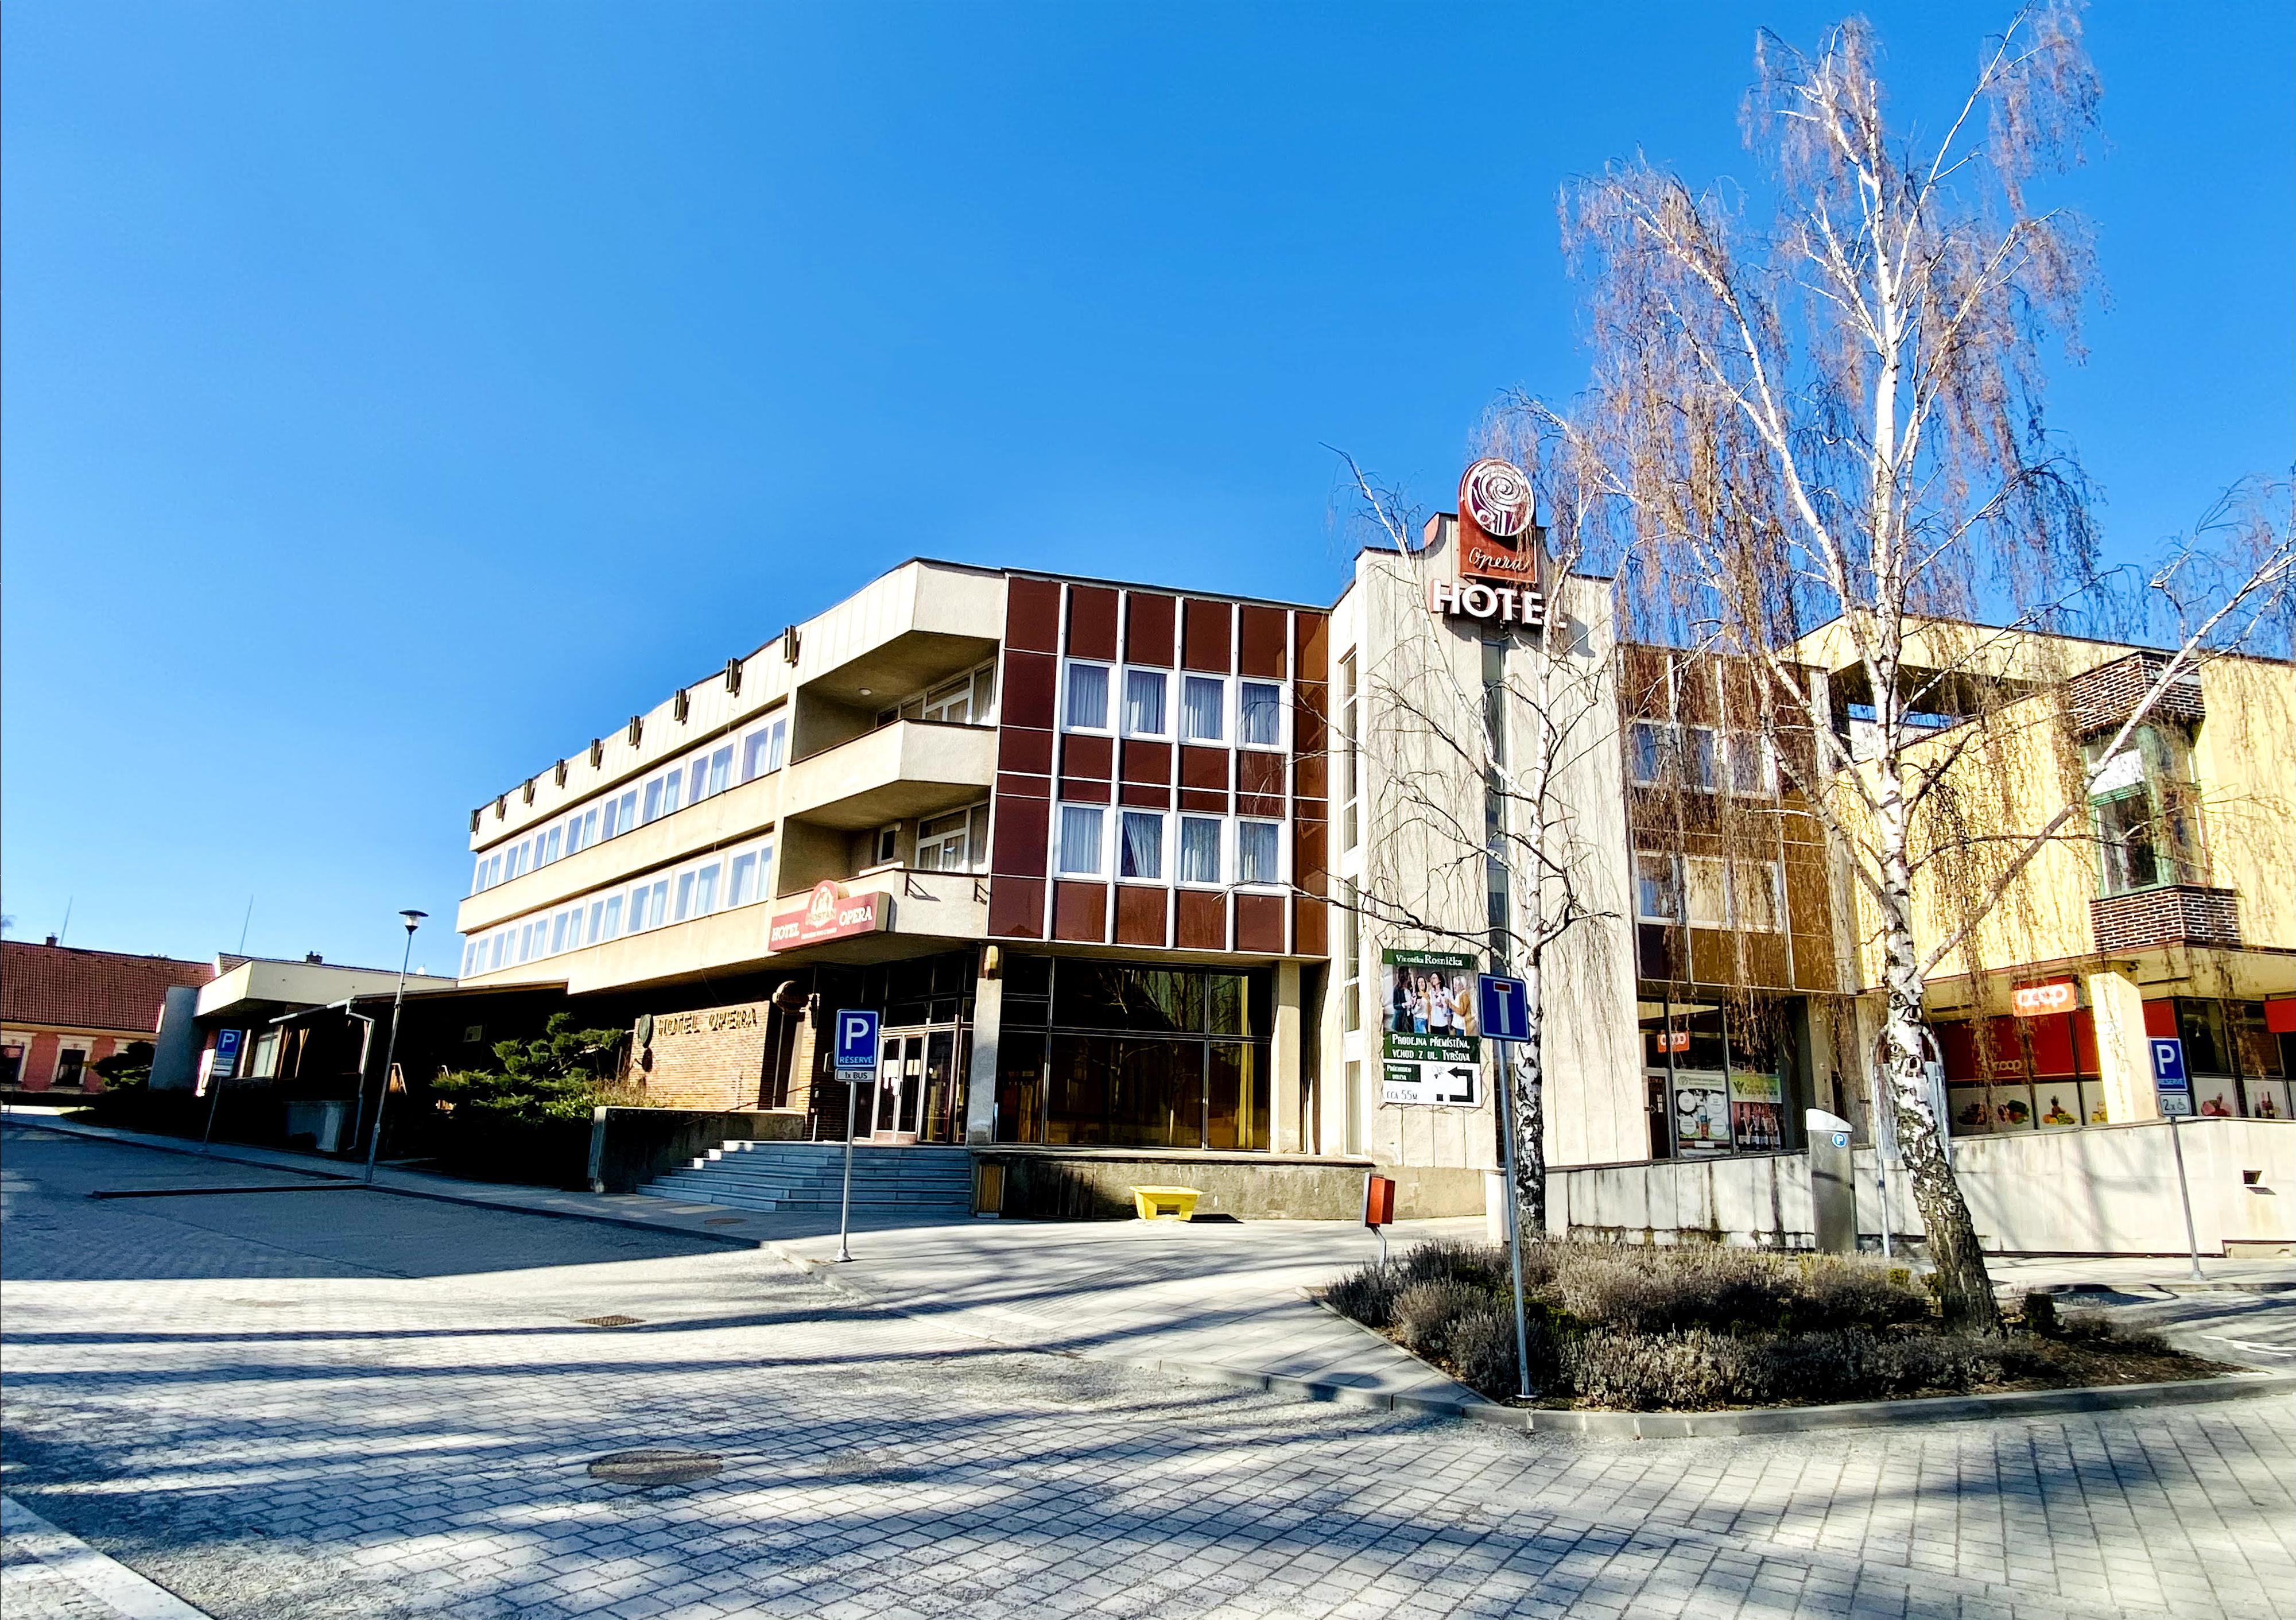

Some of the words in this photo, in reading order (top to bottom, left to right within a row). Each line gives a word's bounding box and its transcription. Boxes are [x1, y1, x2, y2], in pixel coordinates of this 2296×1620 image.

[1469, 547, 1530, 571] Opera
[771, 923, 800, 942] HOTEL
[838, 905, 873, 927] OPERA
[1425, 954, 1463, 966] Rosnička
[658, 1014, 701, 1037] HOTEL
[709, 1007, 757, 1032] OPERA
[221, 1033, 235, 1048] P
[846, 1018, 869, 1049] P
[840, 1055, 873, 1064] RÉSERVÉ
[2156, 1044, 2176, 1075] P
[2162, 1099, 2176, 1111] 2x
[1836, 1135, 1844, 1145] P
